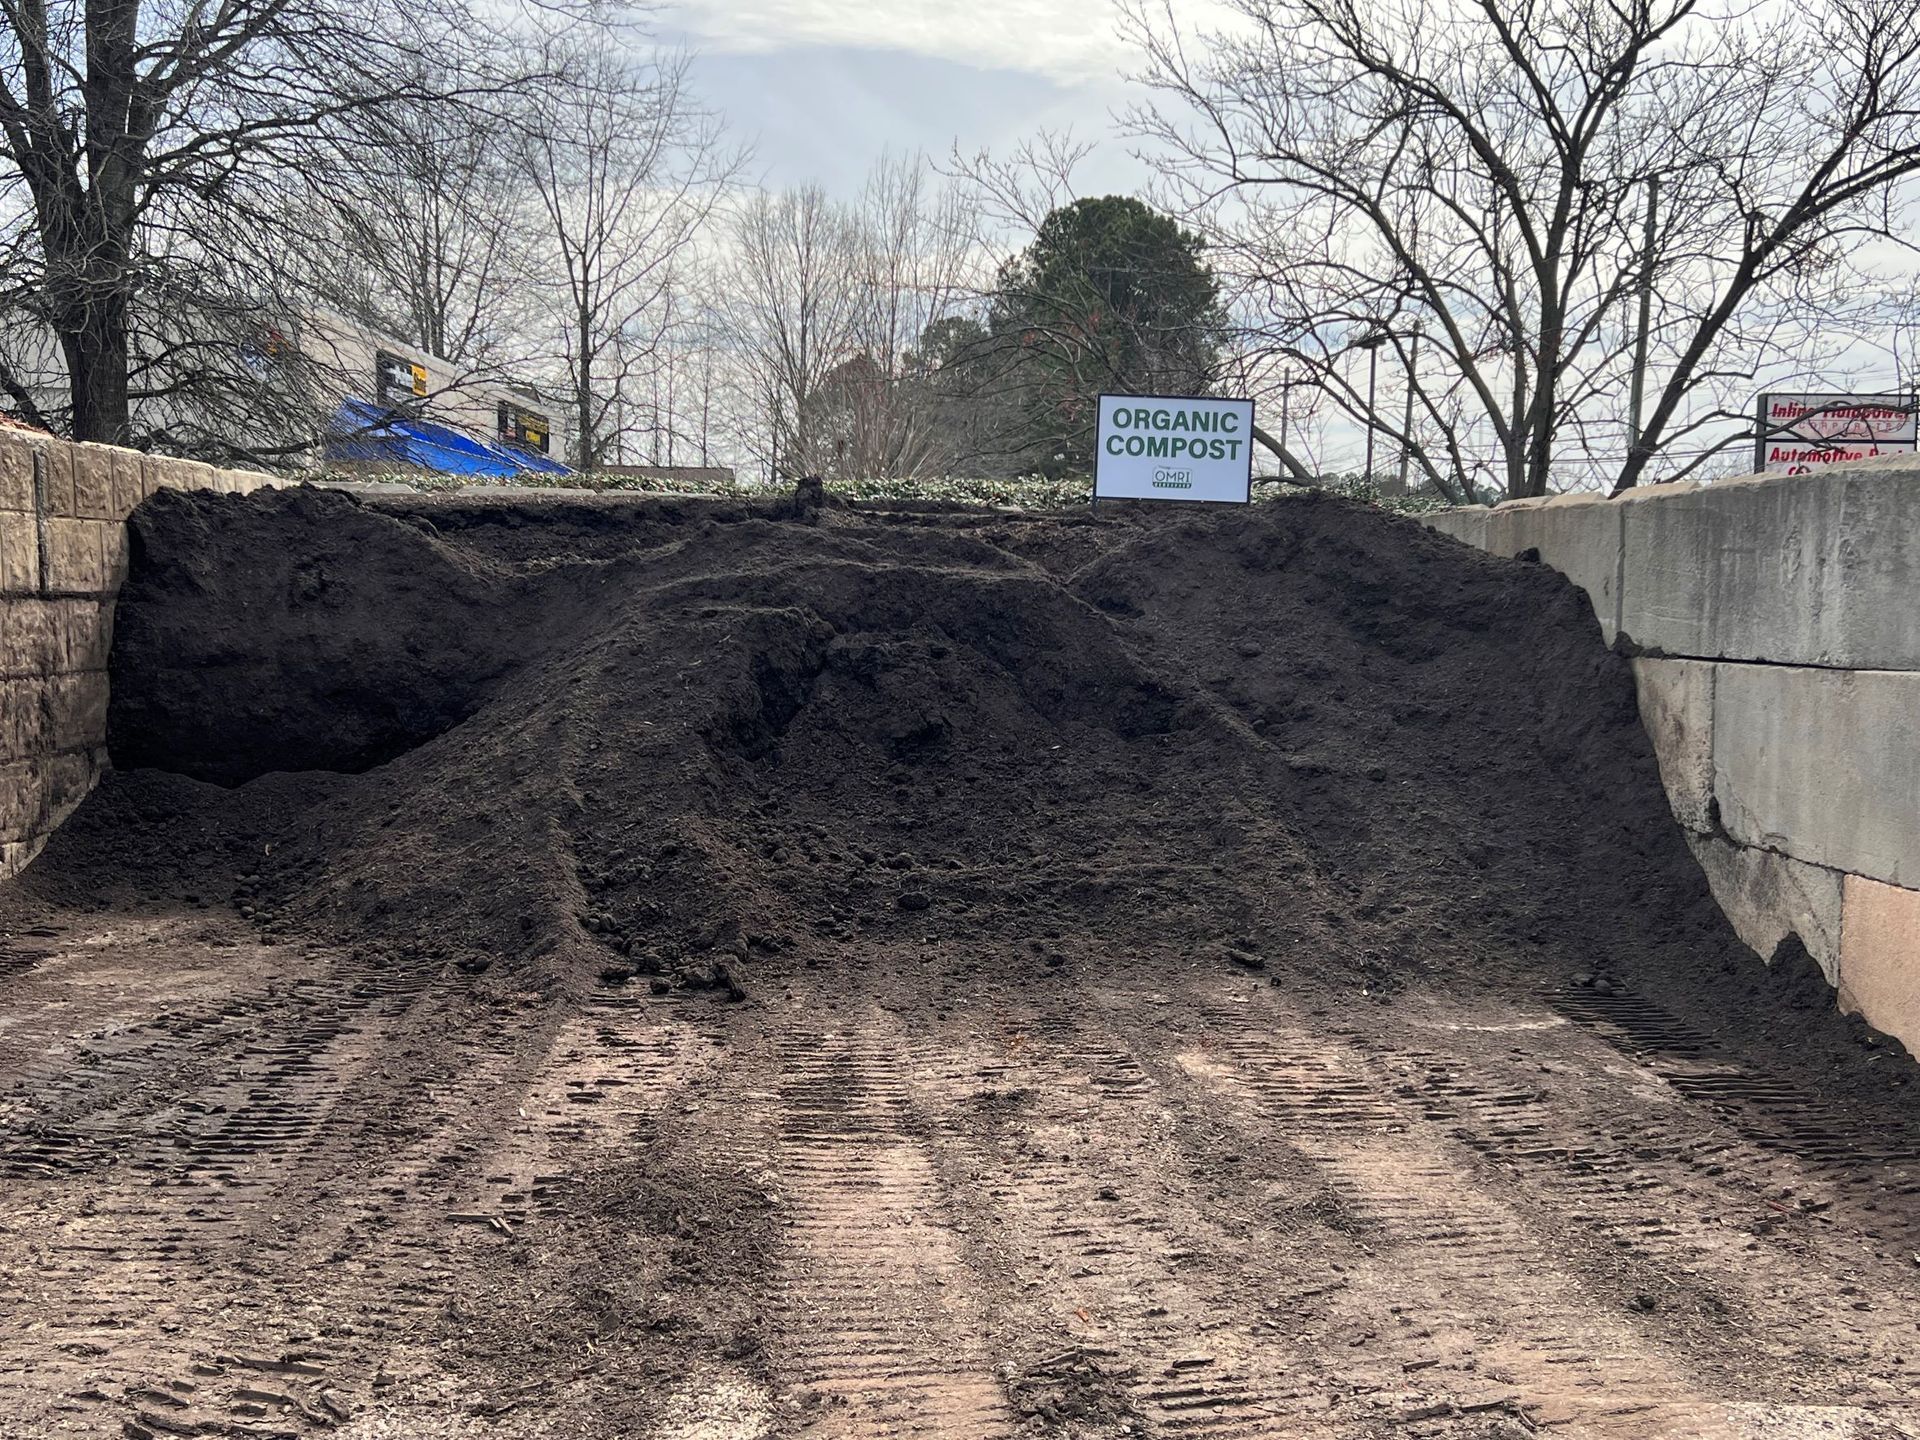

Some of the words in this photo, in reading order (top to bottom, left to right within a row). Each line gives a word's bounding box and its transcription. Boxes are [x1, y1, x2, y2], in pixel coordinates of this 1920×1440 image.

[1112, 408, 1239, 433] ORGANIC
[1106, 435, 1242, 460] COMPOST
[1769, 447, 1863, 463] Automotive
[1155, 470, 1190, 482] OMRI
